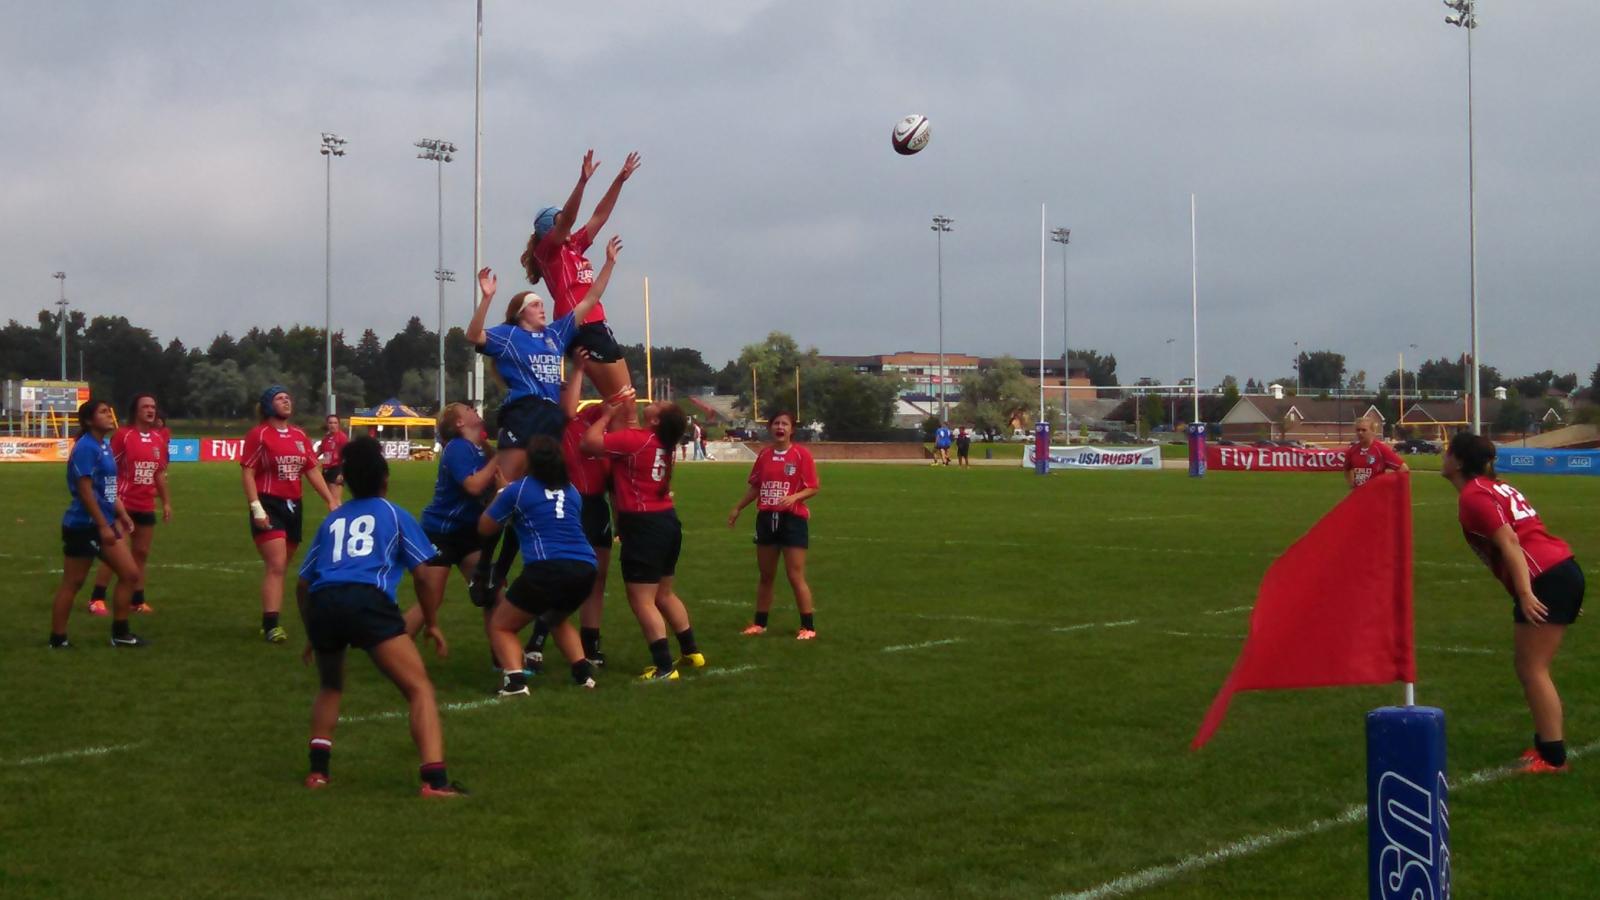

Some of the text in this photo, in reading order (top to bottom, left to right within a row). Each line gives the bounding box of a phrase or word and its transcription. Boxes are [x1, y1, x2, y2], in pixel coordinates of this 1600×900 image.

[212, 440, 236, 460] Fly
[651, 448, 666, 482] 5
[1220, 448, 1346, 470] Fly Emirates
[544, 488, 566, 519] 7
[329, 514, 376, 563] 18
